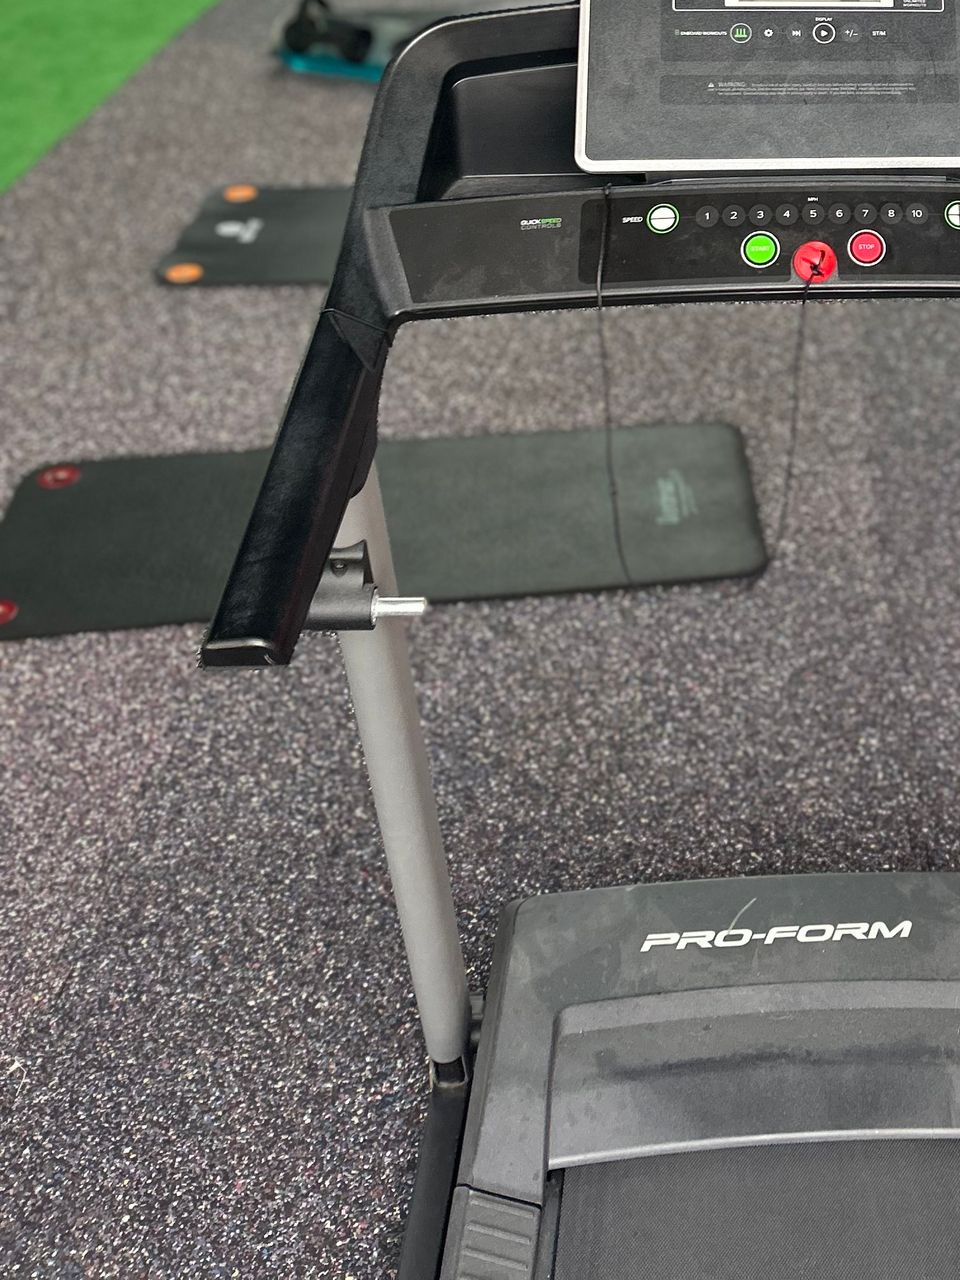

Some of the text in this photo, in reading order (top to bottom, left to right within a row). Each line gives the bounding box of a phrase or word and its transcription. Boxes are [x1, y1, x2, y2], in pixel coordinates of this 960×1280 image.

[730, 212, 738, 220] 2
[756, 210, 764, 219] 3
[783, 210, 791, 218] 4
[809, 209, 817, 218] 5
[835, 209, 843, 218] 6
[862, 209, 869, 217] 7
[911, 209, 923, 217] 10
[520, 223, 562, 231] CONTROLS
[640, 920, 912, 952] PRO-FORM
